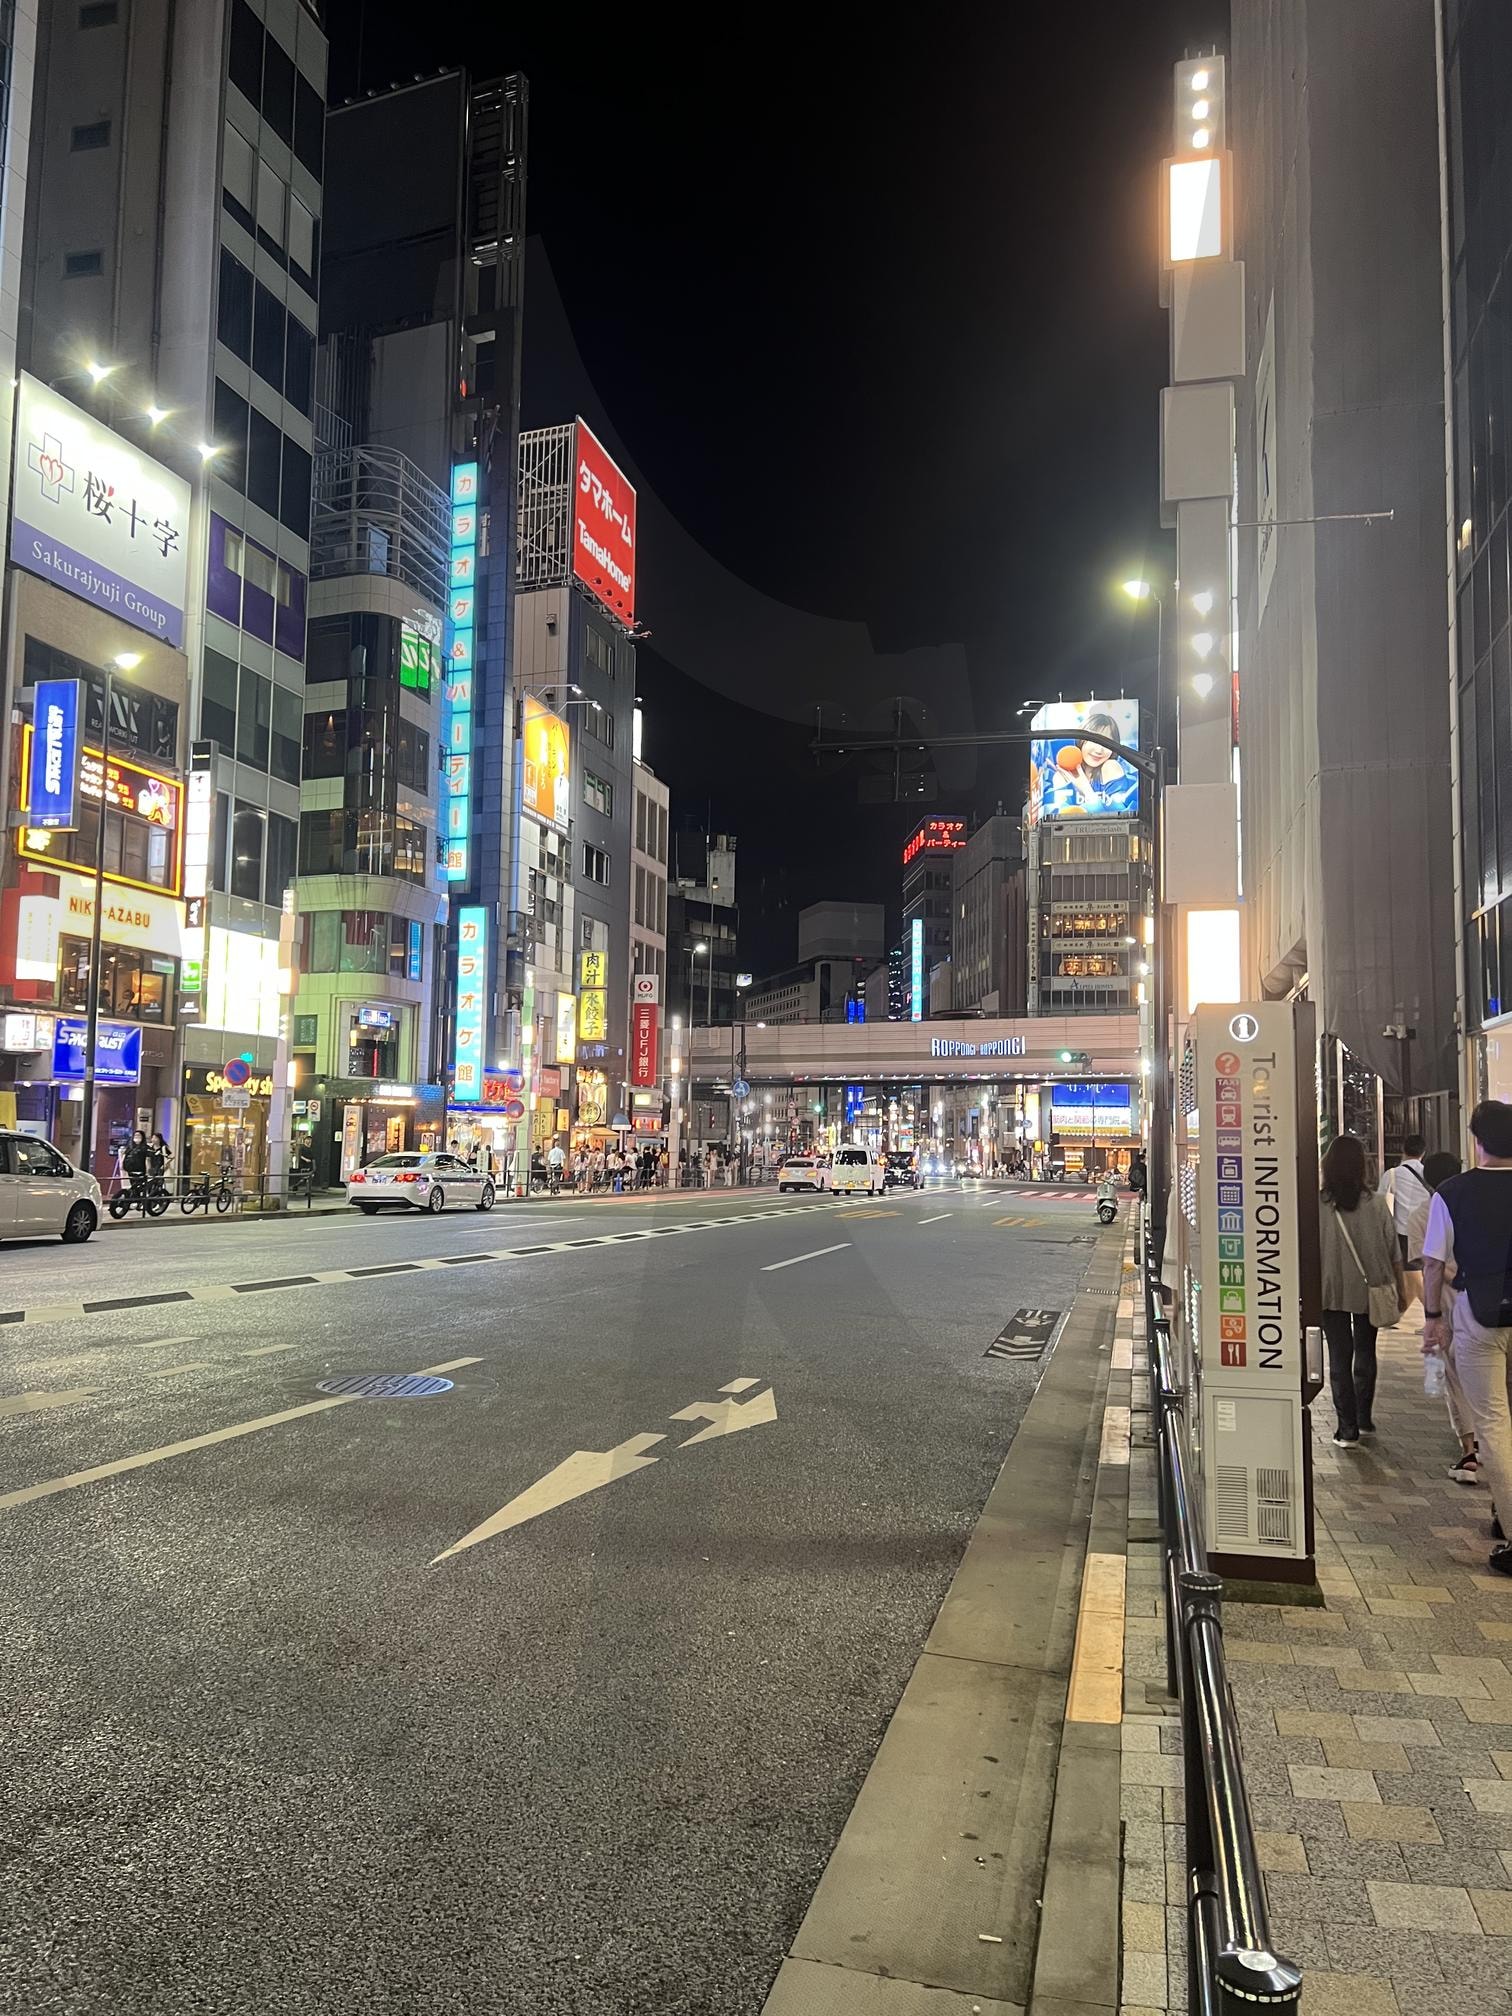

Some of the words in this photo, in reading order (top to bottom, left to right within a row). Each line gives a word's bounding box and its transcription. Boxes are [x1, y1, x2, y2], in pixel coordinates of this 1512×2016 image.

[82, 470, 180, 558] 桜十字
[579, 460, 633, 548] タマホーム
[31, 541, 121, 603] Sakurajyuji
[124, 591, 167, 629] Group
[577, 518, 632, 593] TamaHome
[926, 839, 967, 848] パーティー
[929, 822, 964, 831] カラオケ
[69, 897, 151, 929] NIK-AZABU
[457, 923, 477, 1082] カラオケ館
[586, 952, 601, 985] 肉汁
[584, 992, 600, 1036] 水餃子
[638, 1008, 650, 1078] 三菱UFJ銀行
[1251, 1052, 1278, 1147] Tourist
[1253, 1156, 1284, 1370] INFORMATION
